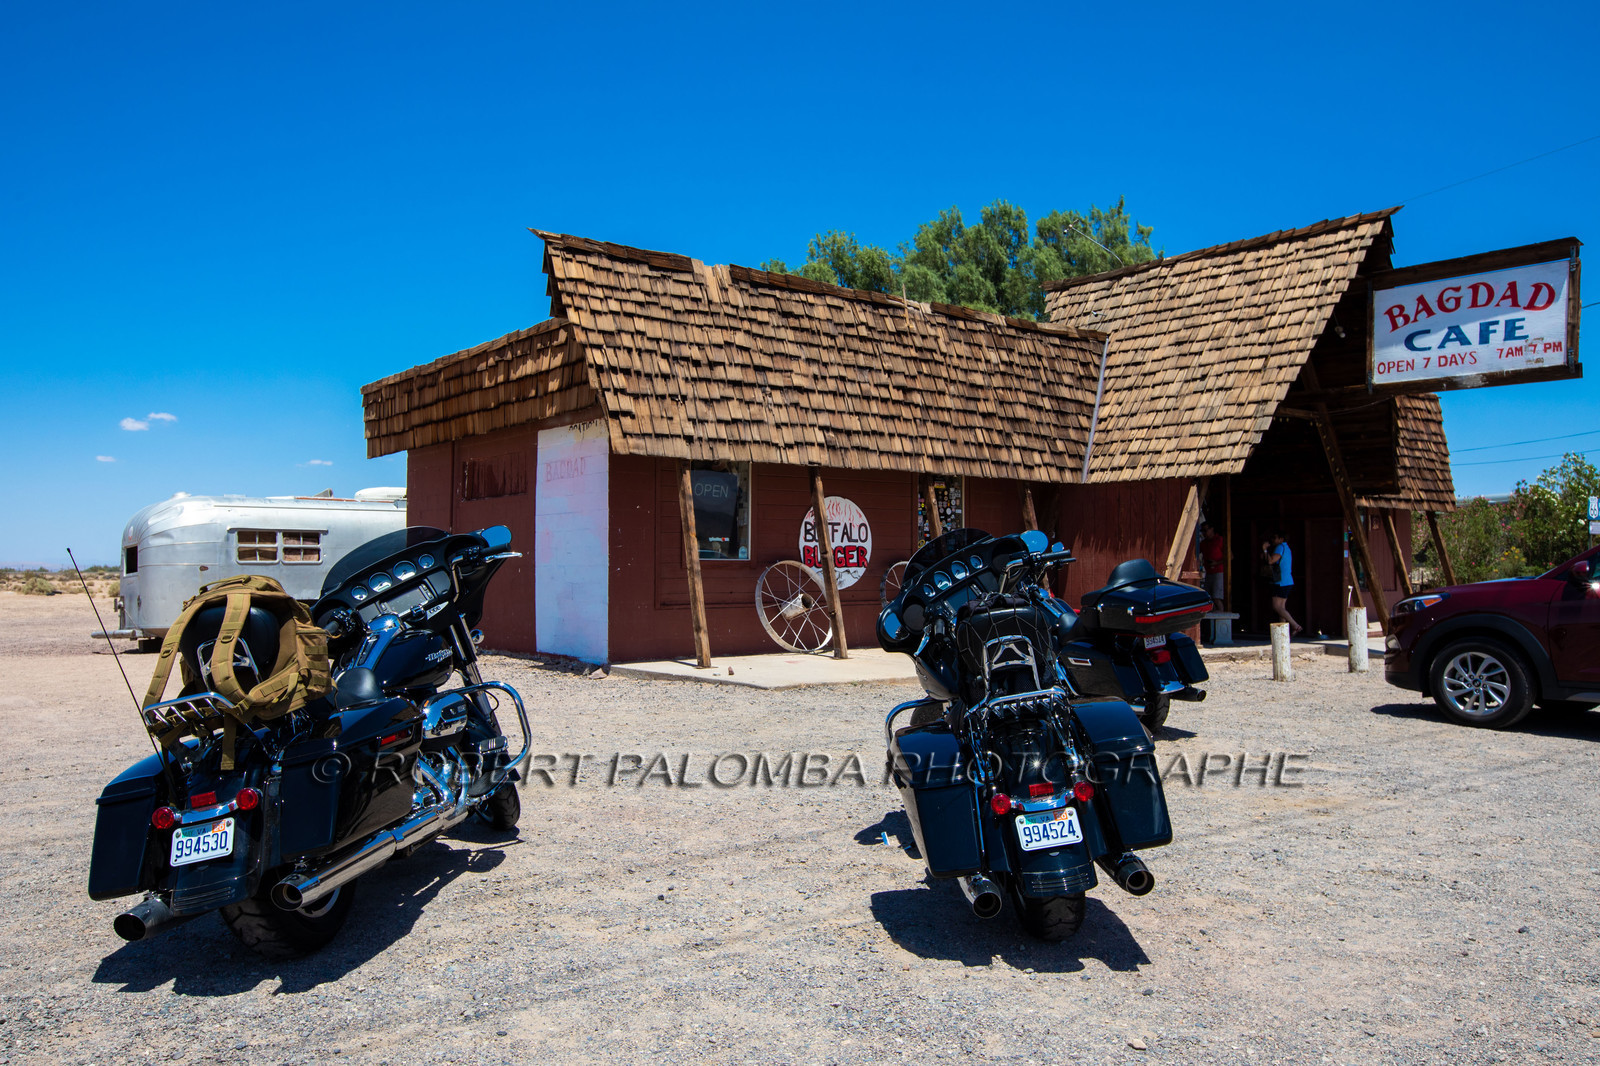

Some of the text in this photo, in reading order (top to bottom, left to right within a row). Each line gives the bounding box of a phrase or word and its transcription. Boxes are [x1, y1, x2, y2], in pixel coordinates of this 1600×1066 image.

[1383, 280, 1556, 333] BAGDAD
[1403, 317, 1529, 352] CAFE
[1376, 358, 1415, 375] OPEN
[1422, 357, 1432, 369] 7
[1437, 351, 1478, 368] DAYS
[1543, 341, 1564, 354] PM
[694, 482, 729, 498] OPEN
[804, 520, 869, 543] BUFALO
[802, 544, 869, 569] BUGER
[175, 830, 228, 859] 994530
[1023, 819, 1076, 844] 994524
